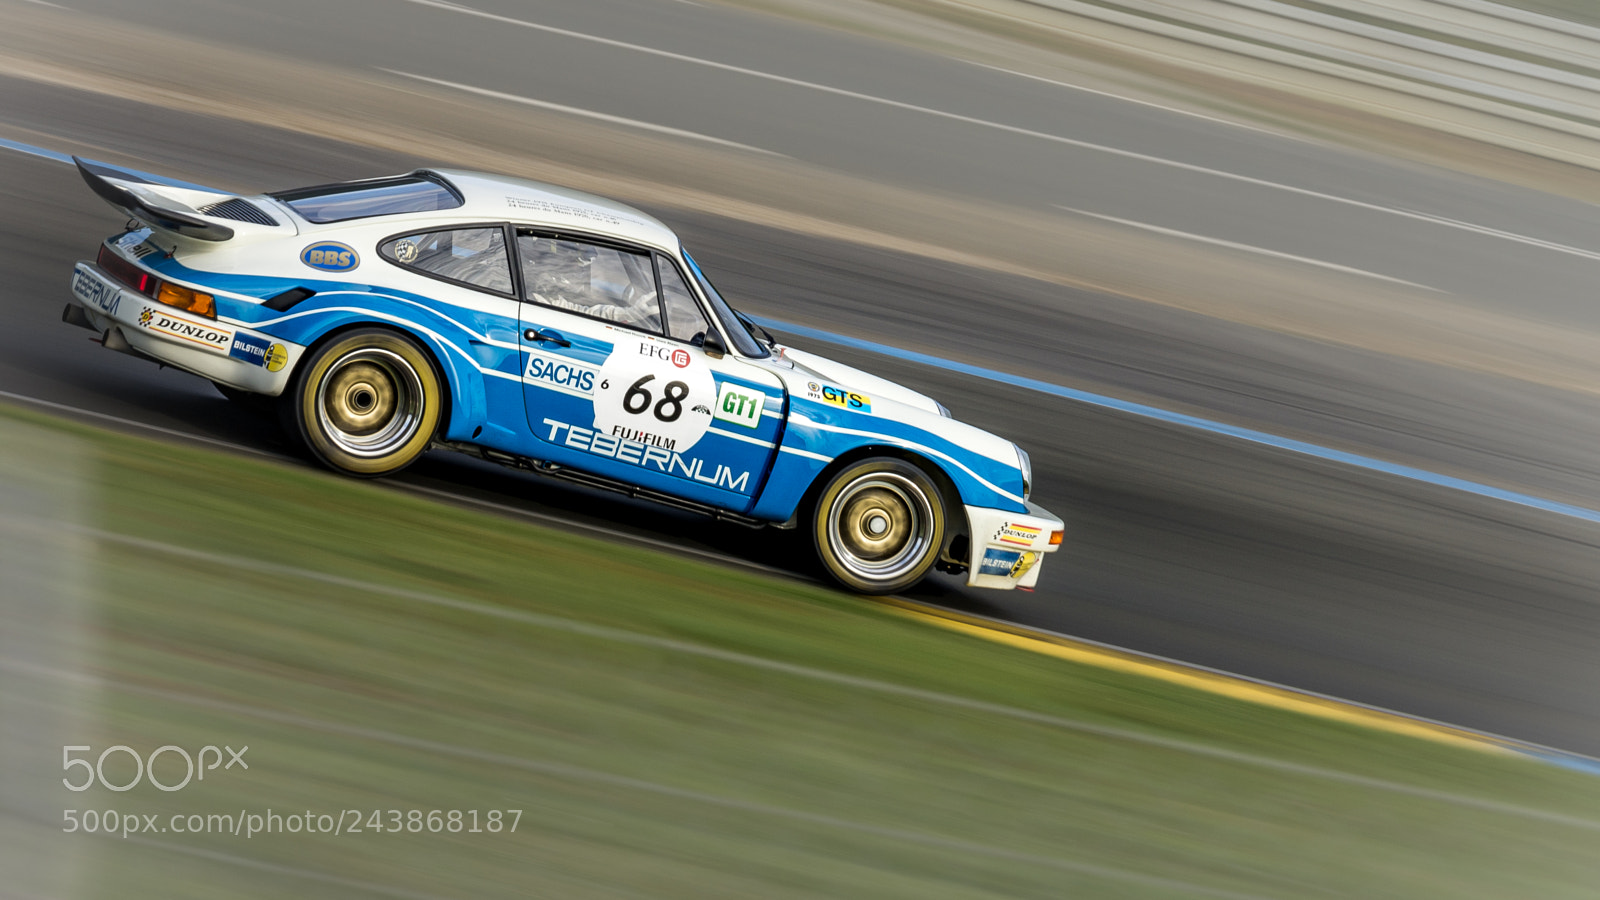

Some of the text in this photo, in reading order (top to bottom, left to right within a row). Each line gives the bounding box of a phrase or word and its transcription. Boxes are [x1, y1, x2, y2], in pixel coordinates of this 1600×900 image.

[309, 250, 352, 267] BBS
[156, 317, 229, 344] DUNLOP
[233, 340, 266, 357] BILSTEIN
[639, 342, 670, 361] EFG
[529, 358, 595, 391] SACHS
[622, 373, 690, 423] 68
[722, 391, 758, 420] GT1
[822, 386, 863, 408] GTS
[611, 425, 676, 450] FUJIFILM
[543, 417, 750, 492] TEBERNUM
[1003, 529, 1038, 540] DUNLOP
[982, 557, 1014, 569] BILSTEIN
